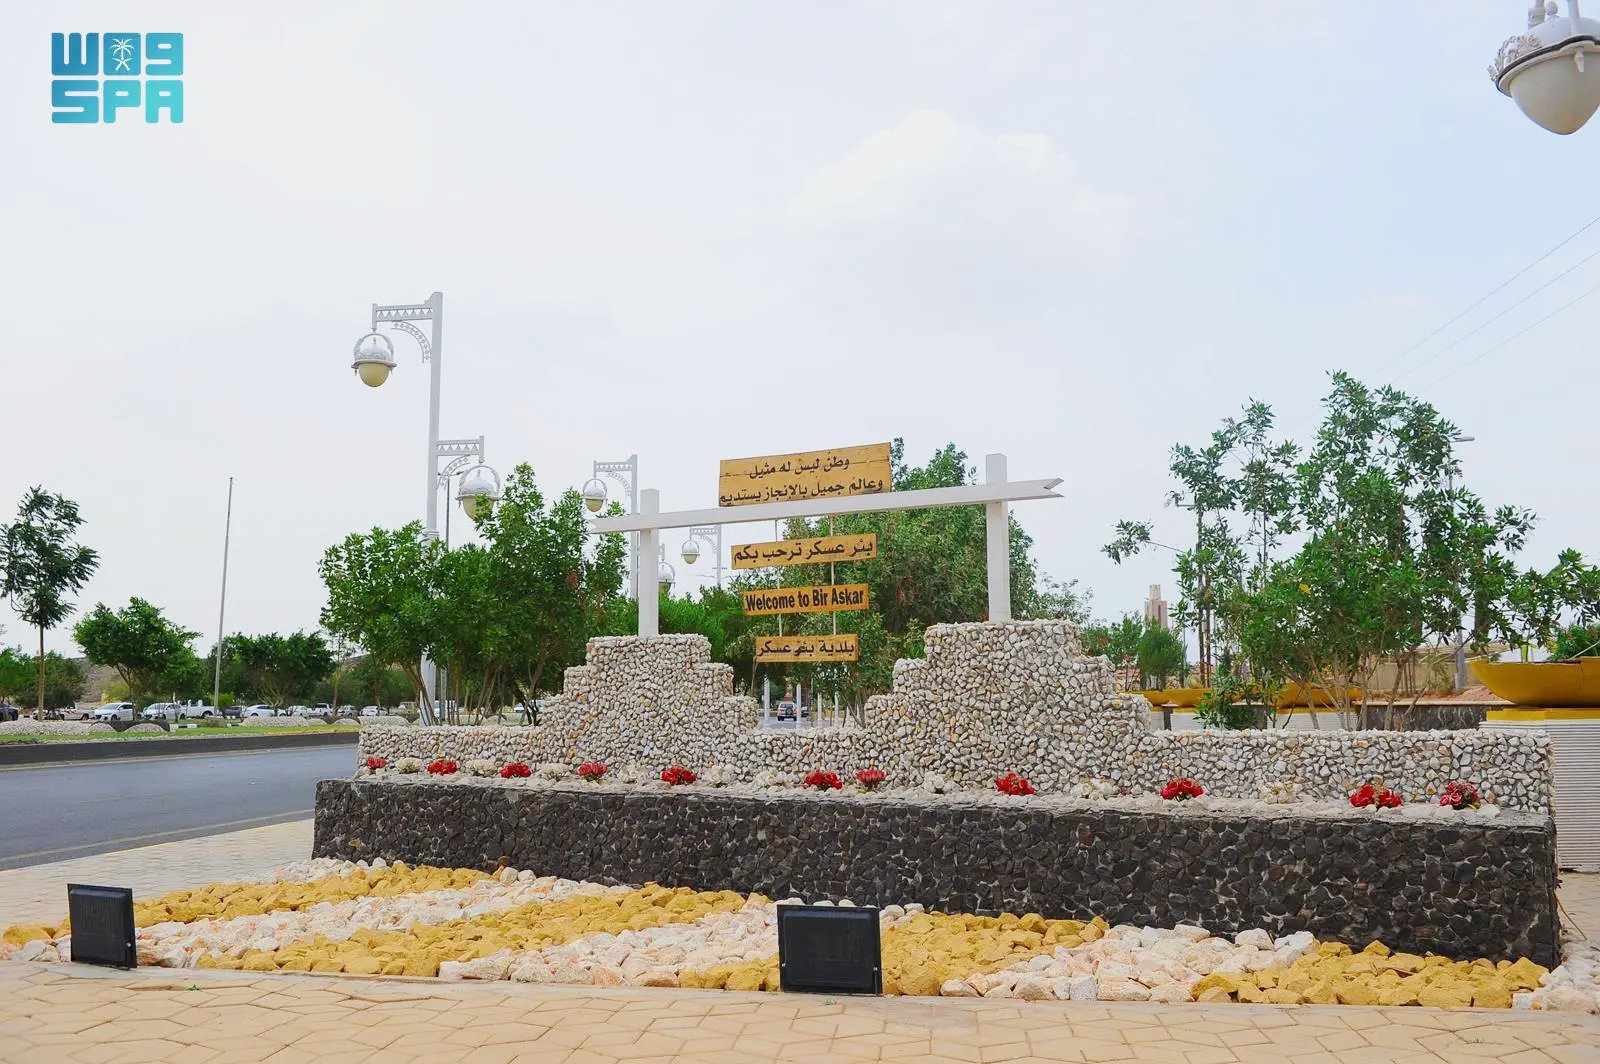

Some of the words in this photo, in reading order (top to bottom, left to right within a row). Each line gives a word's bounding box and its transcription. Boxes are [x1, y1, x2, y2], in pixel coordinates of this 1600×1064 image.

[749, 462, 776, 479] مثيل
[778, 461, 791, 473] له
[794, 458, 820, 475] ليس
[823, 455, 850, 472] وطن
[811, 482, 845, 497] جميل
[734, 545, 759, 564] بكم
[762, 542, 802, 561] ترحب
[805, 540, 845, 559] عسكر
[848, 538, 873, 557] بئر
[745, 594, 795, 611] Welcome
[797, 591, 810, 608] to
[812, 588, 828, 606] Bir
[831, 587, 864, 605] Askar
[757, 640, 792, 657] عسكر
[818, 640, 854, 657] بلدية
